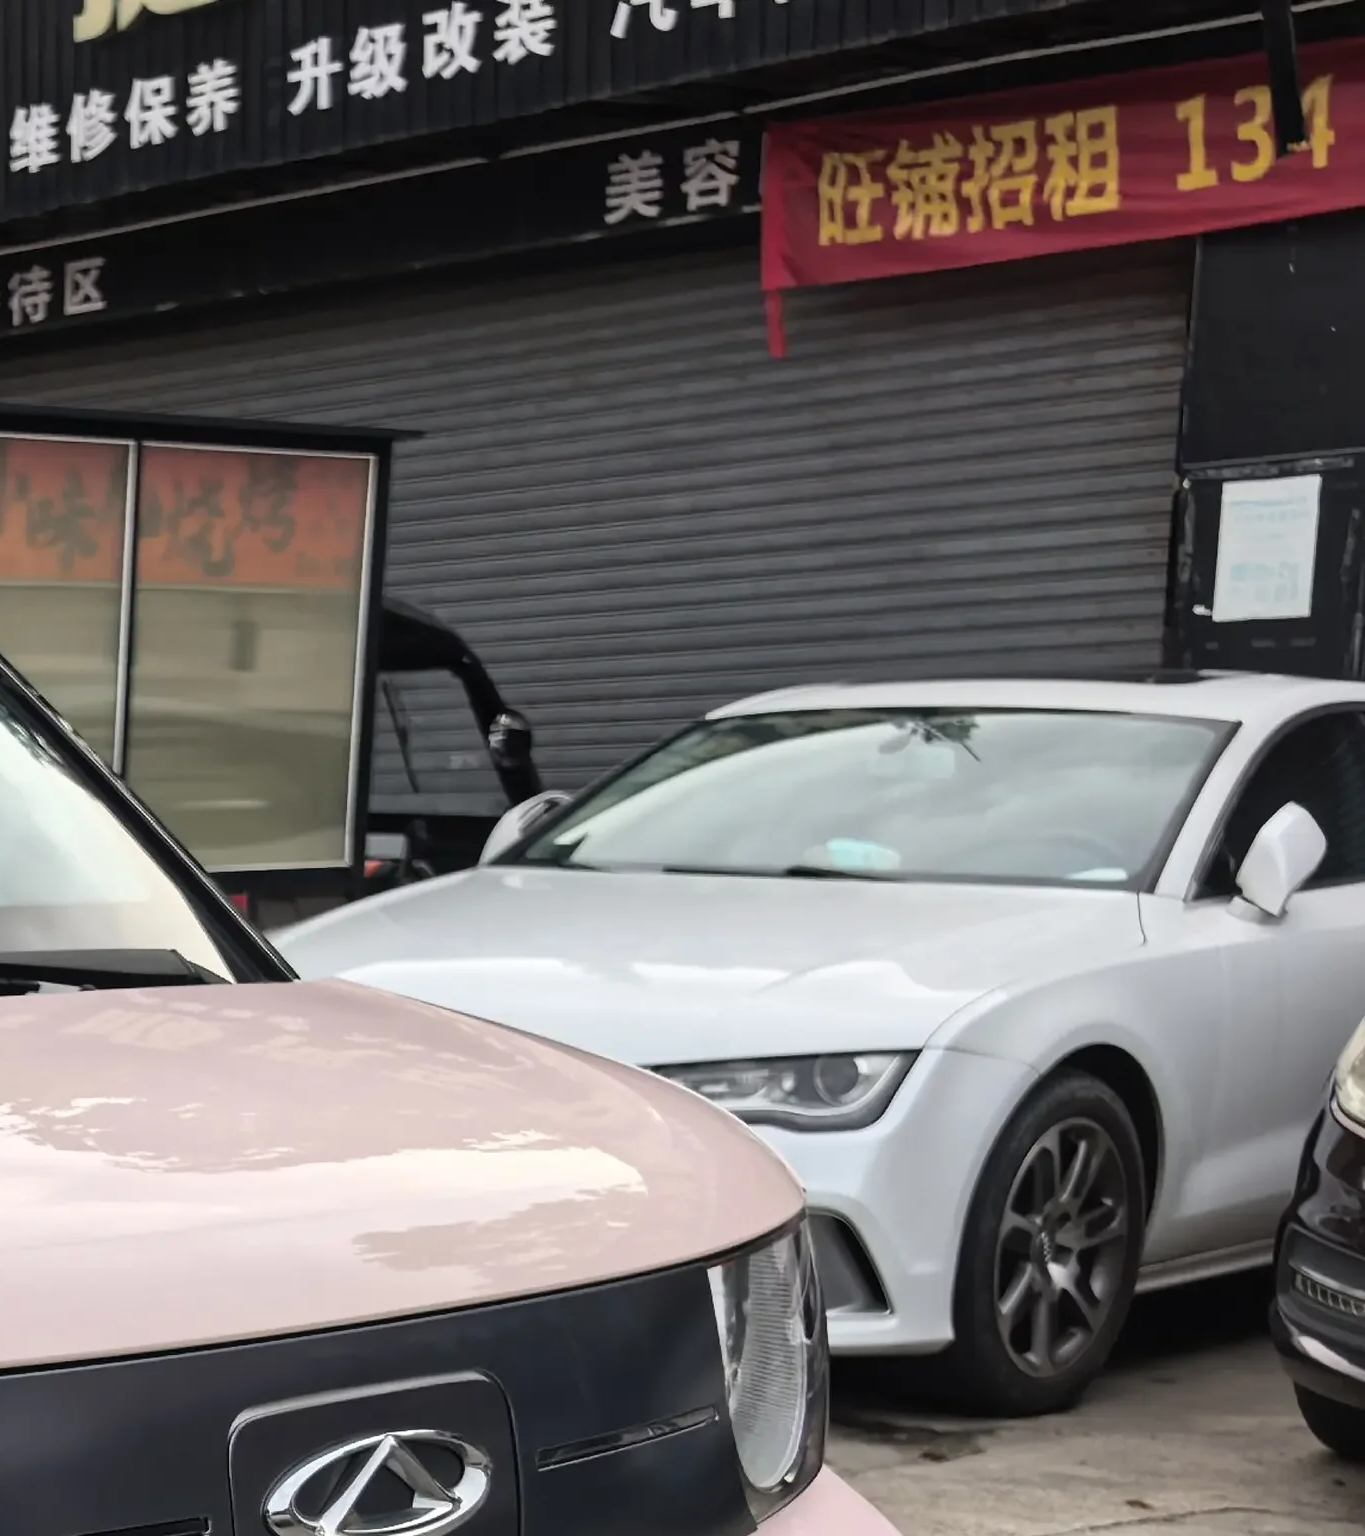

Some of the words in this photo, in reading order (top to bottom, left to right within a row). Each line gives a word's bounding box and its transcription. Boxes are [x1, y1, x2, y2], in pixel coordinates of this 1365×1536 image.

[9, 59, 241, 174] 维修保养
[287, 0, 557, 117] 升级改装
[603, 138, 741, 225] 美容
[818, 105, 1120, 246] 旺铺招租
